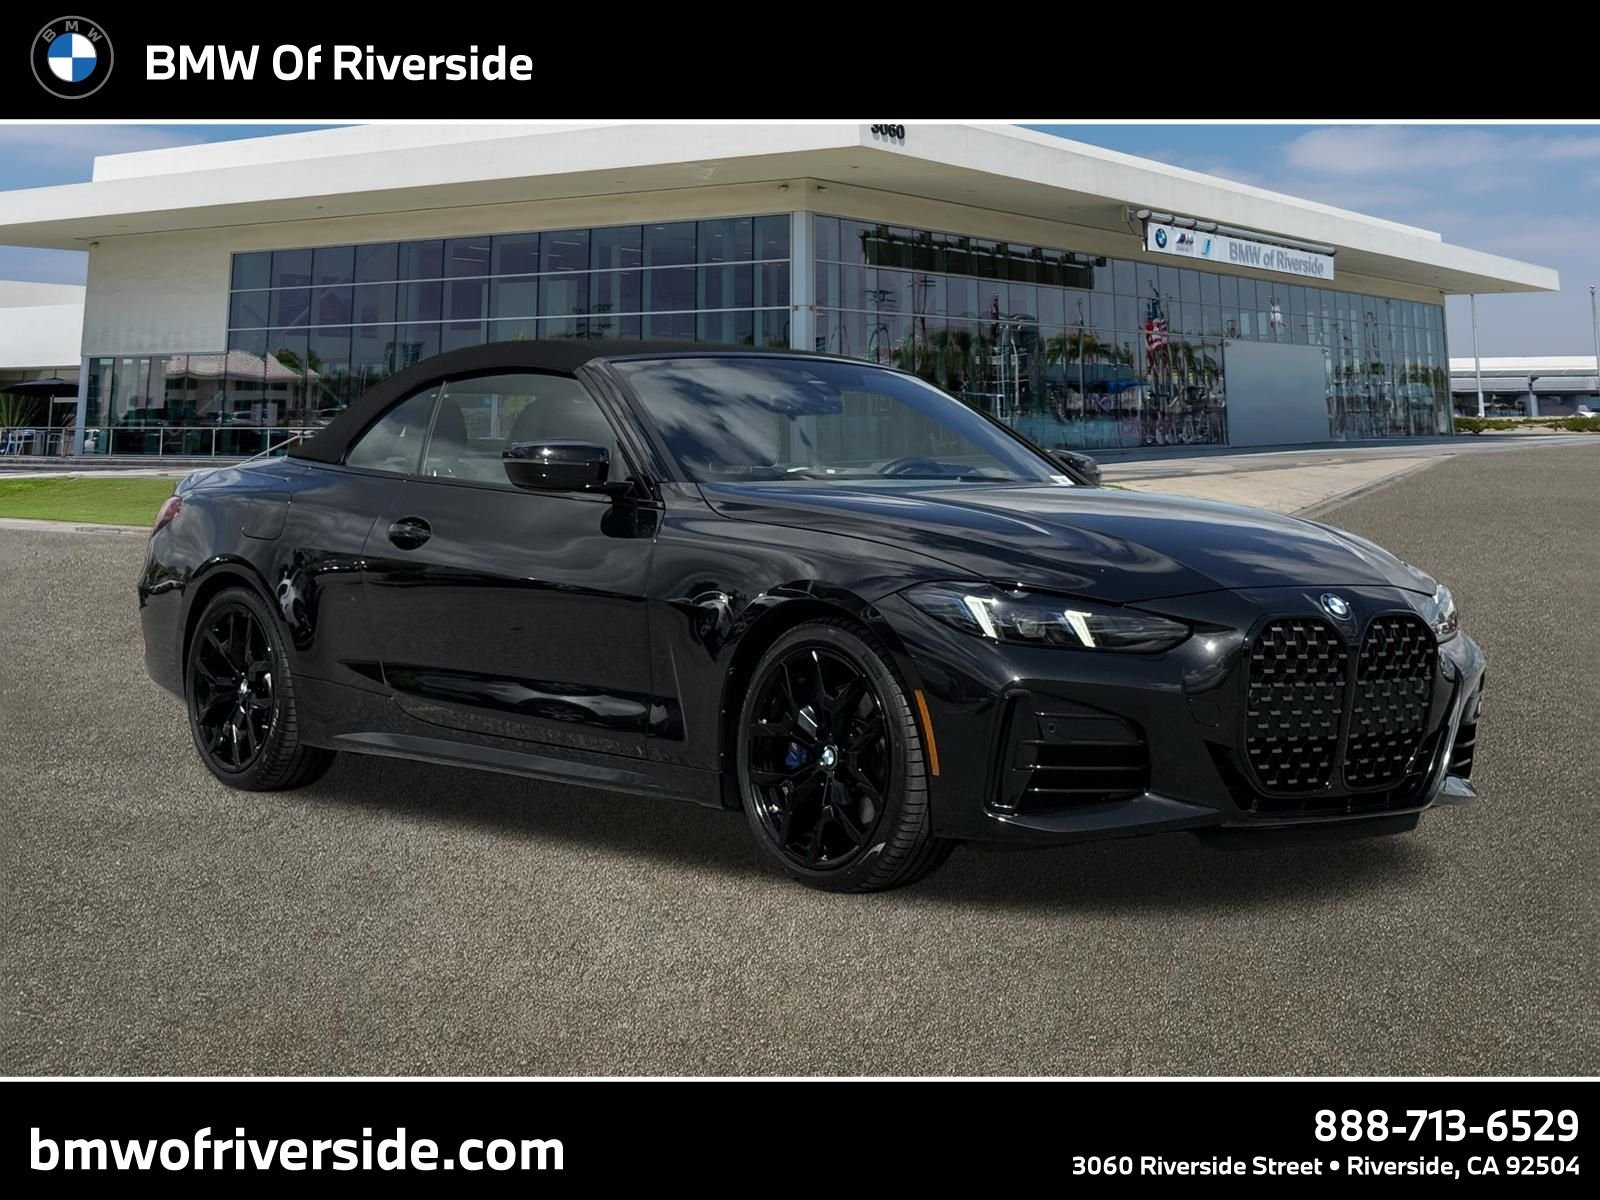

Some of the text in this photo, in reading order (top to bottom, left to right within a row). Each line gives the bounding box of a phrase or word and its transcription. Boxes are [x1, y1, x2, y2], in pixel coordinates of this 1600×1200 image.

[1229, 241, 1261, 265] BMW
[1263, 249, 1275, 267] of
[1276, 250, 1324, 275] Riverside
